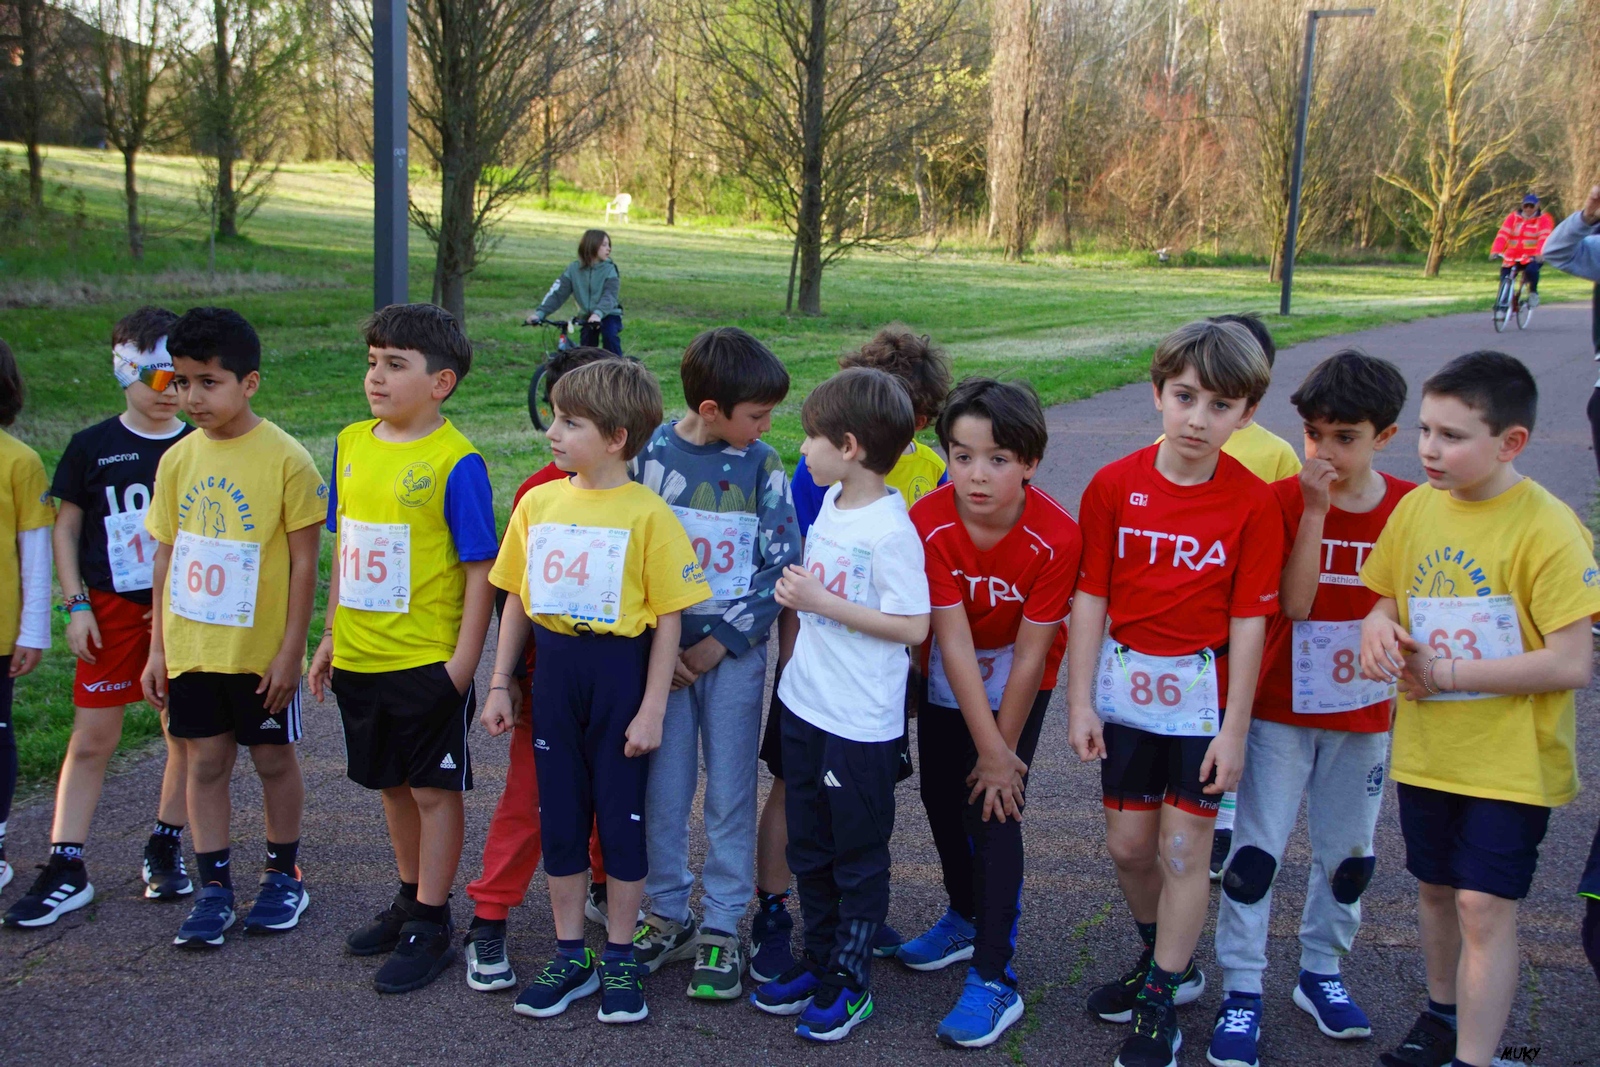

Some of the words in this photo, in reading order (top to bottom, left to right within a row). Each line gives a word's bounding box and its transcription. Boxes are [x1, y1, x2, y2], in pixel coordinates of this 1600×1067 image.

[98, 452, 140, 467] macron
[127, 533, 156, 564] 1
[342, 544, 388, 584] 115
[691, 538, 735, 574] 03
[187, 560, 226, 597] 60
[542, 549, 590, 586] 64
[806, 556, 848, 600] 04
[1321, 574, 1359, 585] Triathlon
[1428, 628, 1482, 660] 63
[1331, 648, 1368, 684] 8
[99, 680, 133, 693] LEGEA
[1130, 671, 1182, 707] 86
